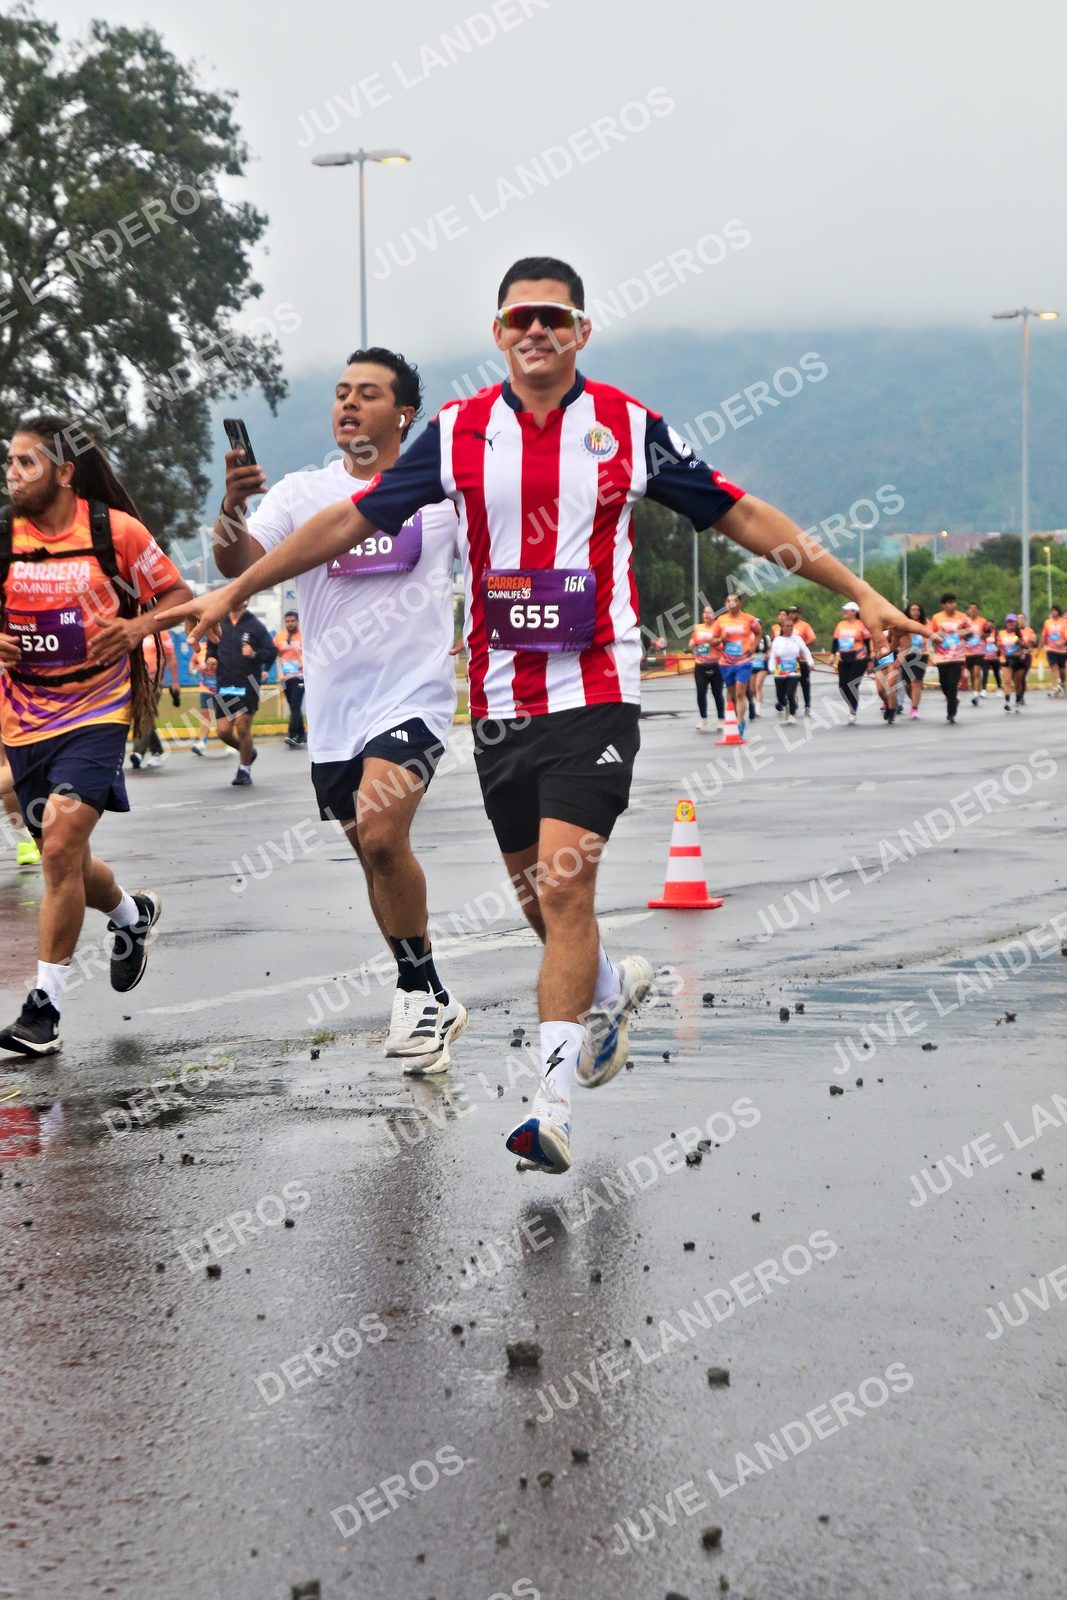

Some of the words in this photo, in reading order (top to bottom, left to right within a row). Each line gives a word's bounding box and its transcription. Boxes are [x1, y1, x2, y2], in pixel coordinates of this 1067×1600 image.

[12, 561, 90, 580] CARRERA
[12, 581, 72, 594] OMNILIFE
[487, 576, 532, 589] CARRERA
[487, 590, 520, 599] OMNILIFE
[509, 605, 560, 628] 655
[21, 634, 59, 652] 520
